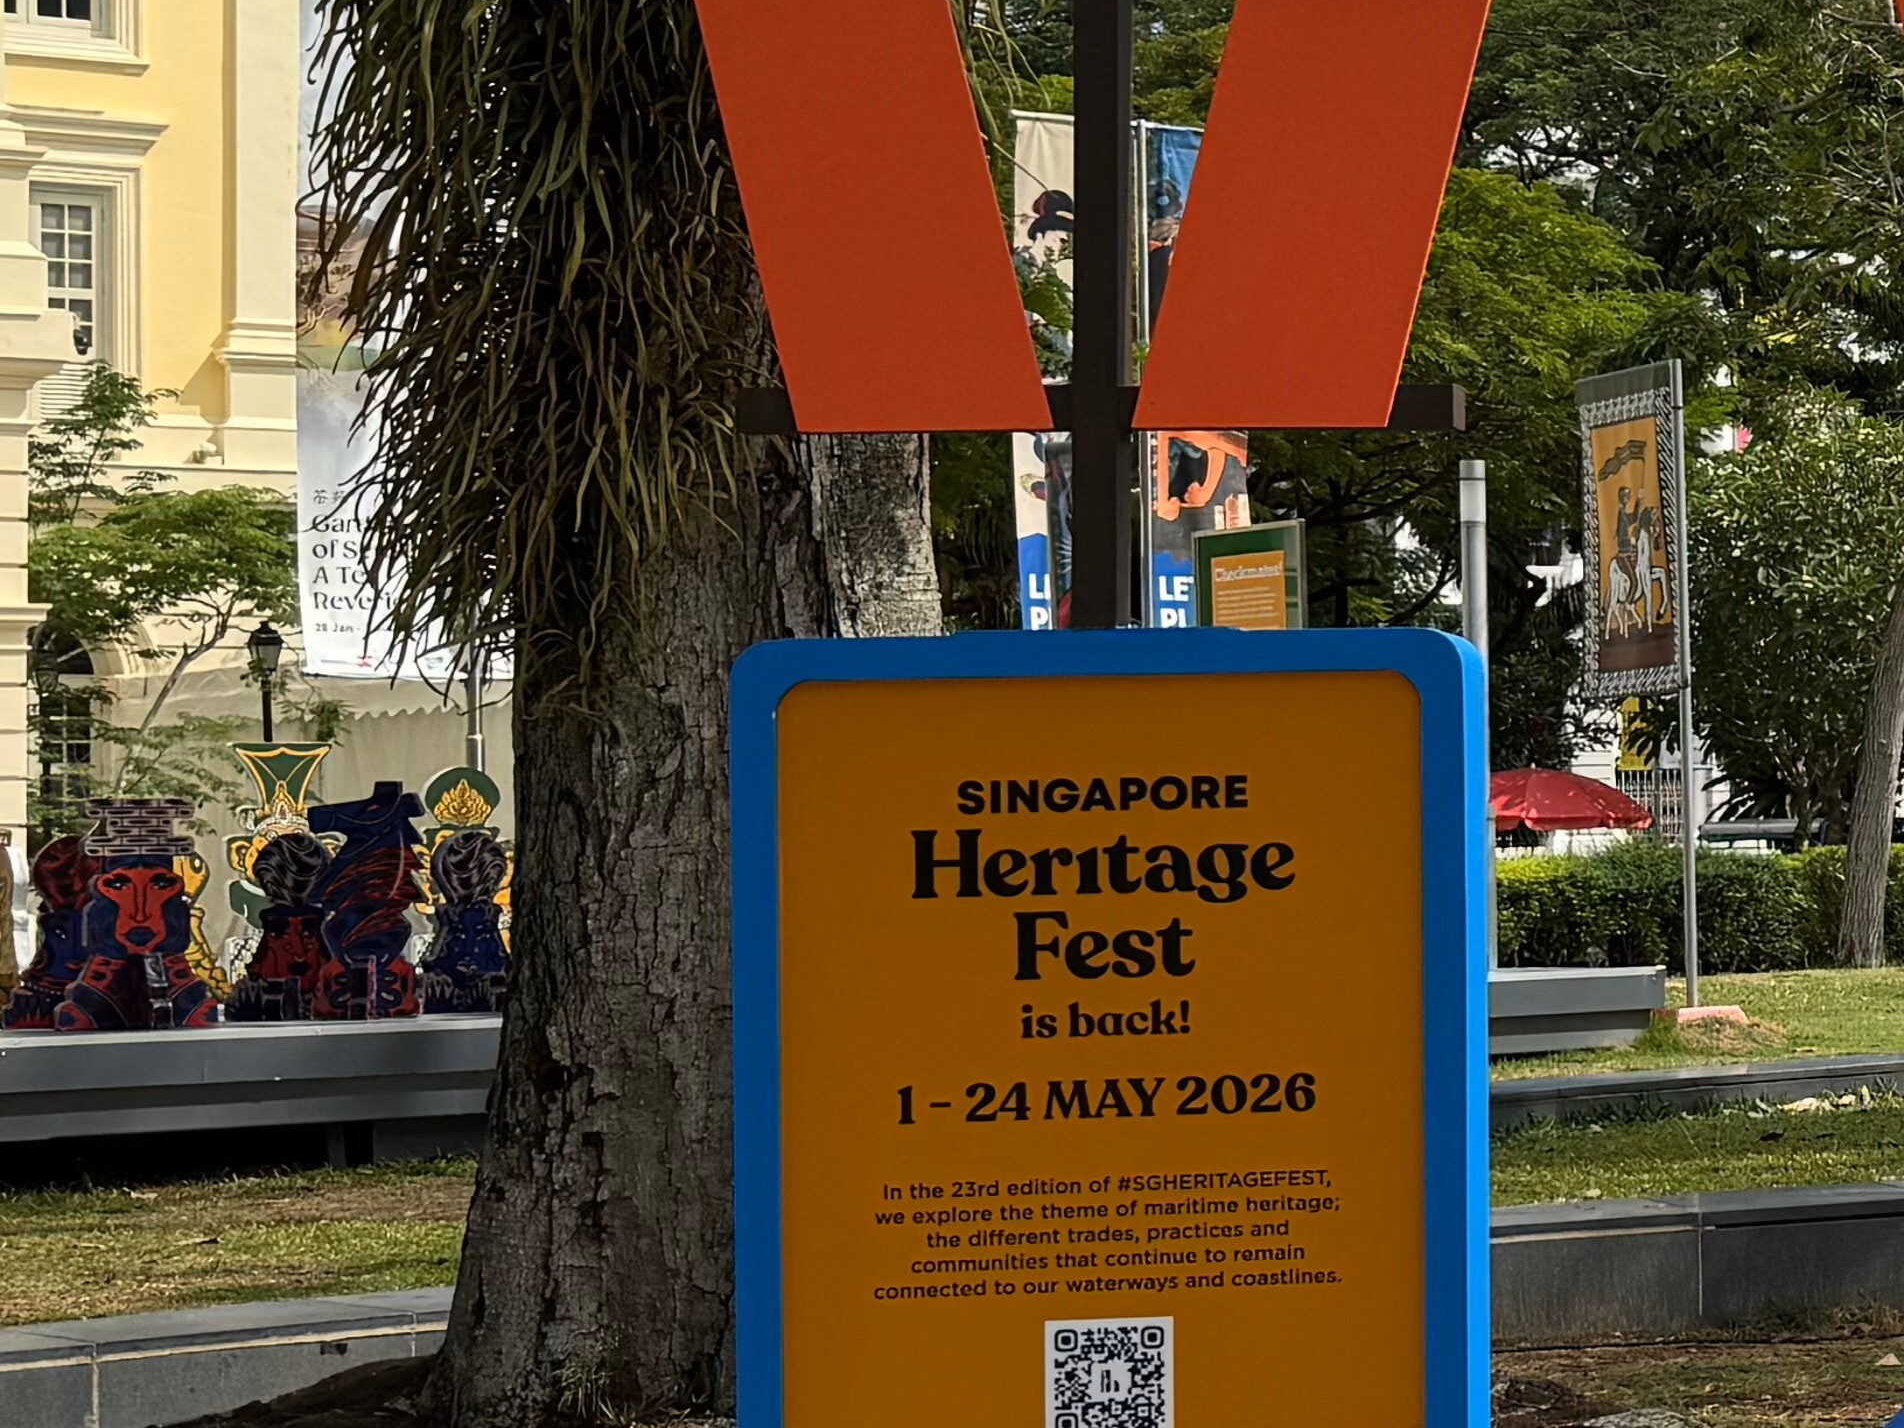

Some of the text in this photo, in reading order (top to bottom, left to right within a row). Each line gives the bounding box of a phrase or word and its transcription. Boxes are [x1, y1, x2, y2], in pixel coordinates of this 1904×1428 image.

[312, 538, 339, 559] of
[957, 775, 1249, 816] SINGAPORE
[911, 828, 1296, 904] Heritage
[1013, 910, 1196, 981] Fest
[1021, 999, 1191, 1039] is back!
[897, 1085, 916, 1125] 1
[965, 1081, 1031, 1123] 24
[1043, 1077, 1166, 1121] MAY
[1176, 1072, 1317, 1116] 2026
[883, 1169, 1332, 1200] In the 23rd edition of #SGHERITAGEFEST,
[875, 1195, 1340, 1227] we explore the theme of maritime heritage;
[926, 1219, 1289, 1248] the different trades, practices and
[911, 1243, 1305, 1274] communities that continue to remain
[874, 1267, 1343, 1300] connected to our waterways and coastlines.
